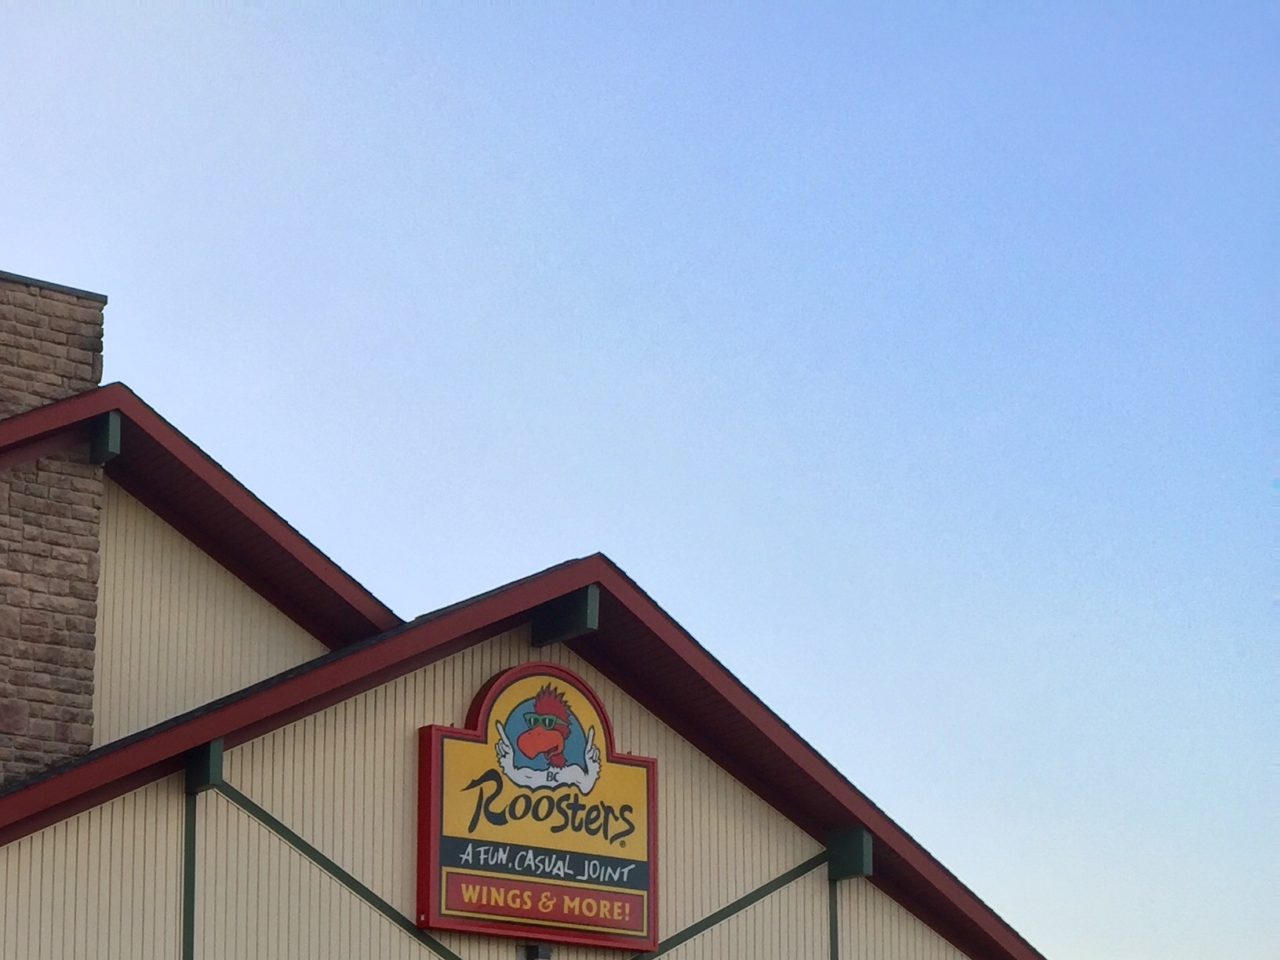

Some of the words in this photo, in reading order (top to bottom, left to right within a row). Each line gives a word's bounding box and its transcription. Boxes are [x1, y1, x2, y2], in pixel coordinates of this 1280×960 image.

[546, 771, 560, 783] BC
[460, 768, 636, 844] Roosters
[459, 843, 473, 865] A
[514, 850, 574, 878] CASUAL
[577, 860, 636, 883] JOINT
[461, 883, 532, 910] WINGS
[538, 892, 557, 913] &
[563, 895, 630, 921] MORE!
